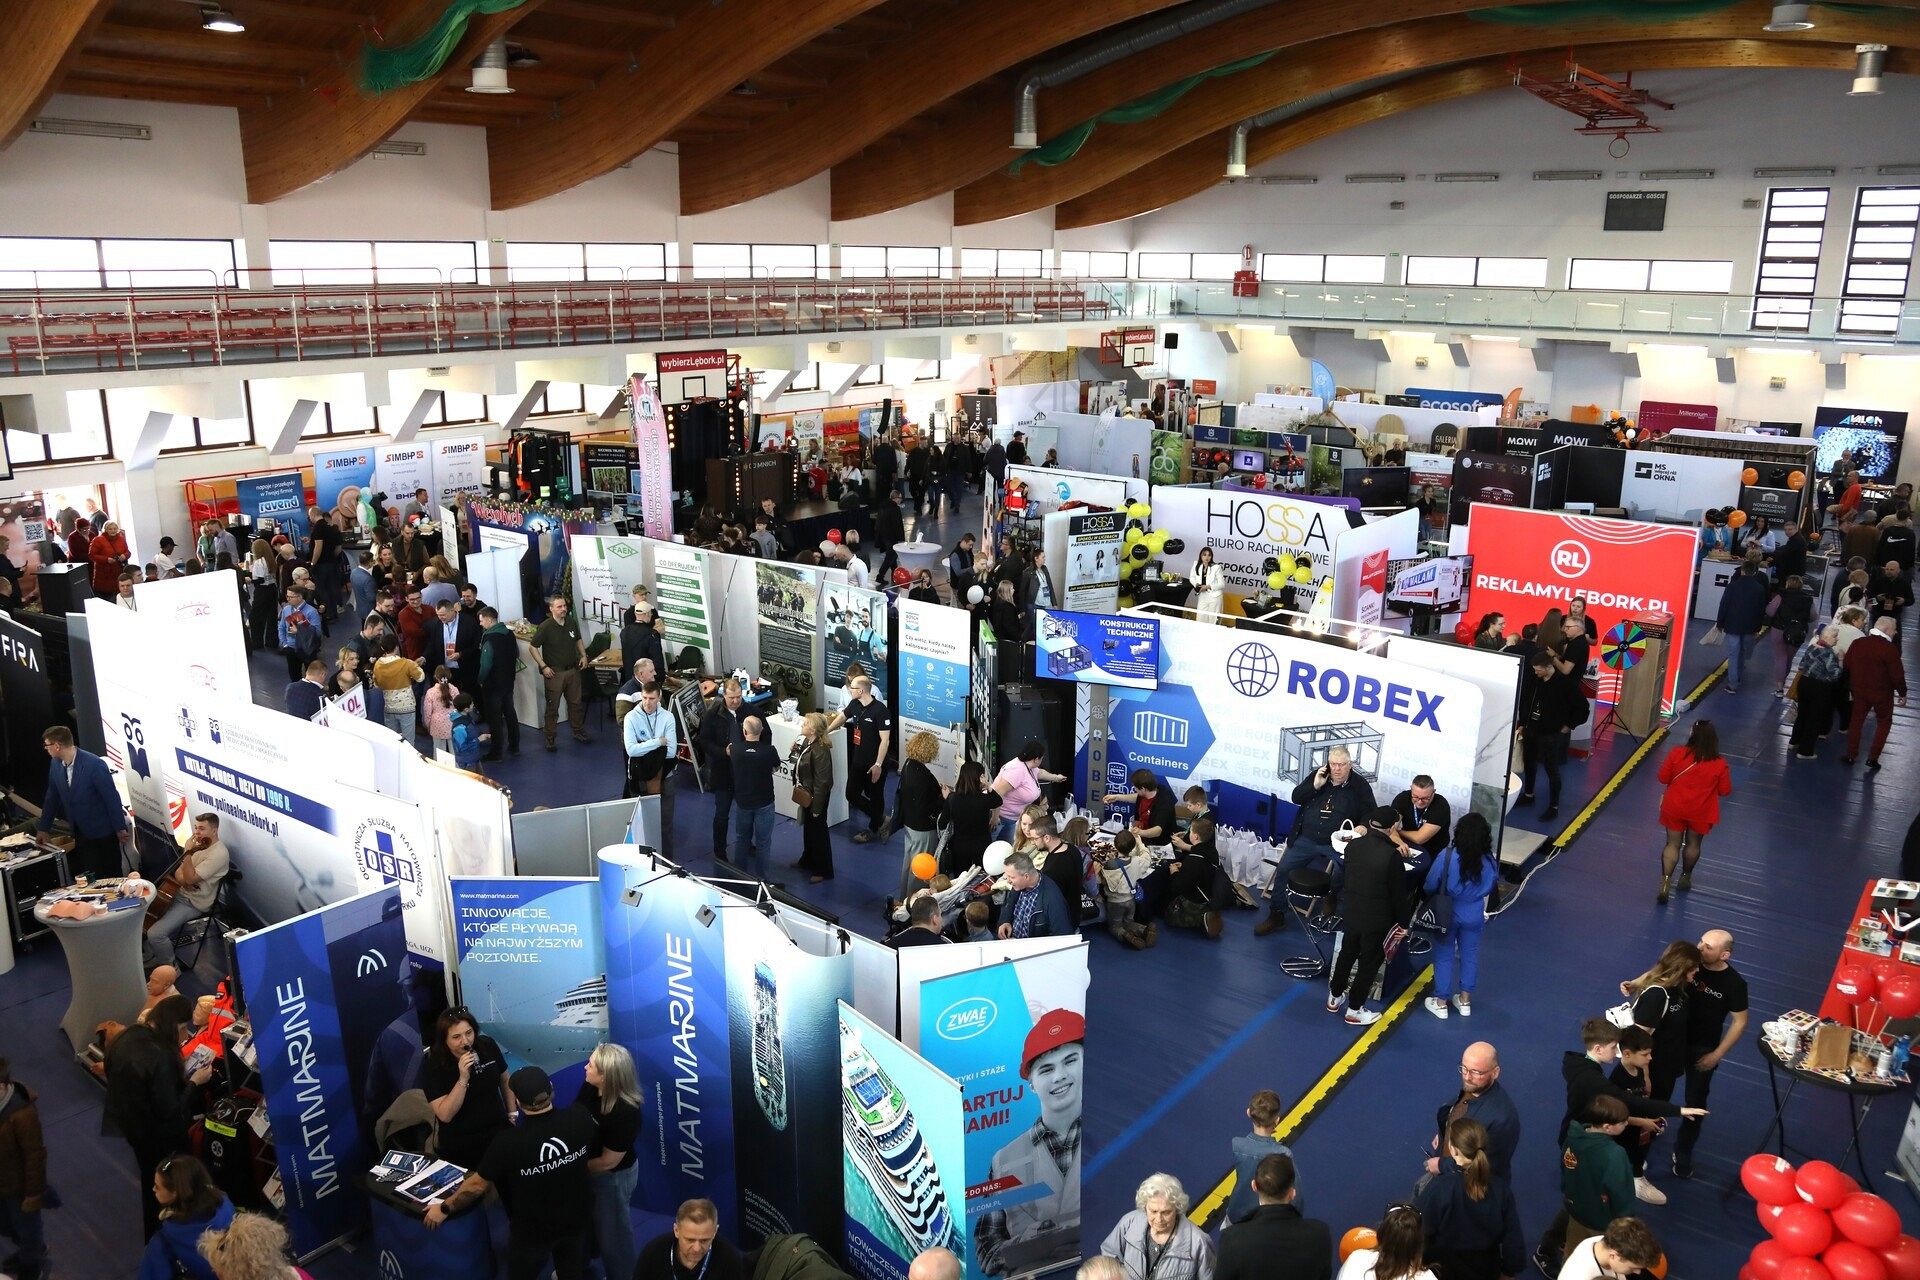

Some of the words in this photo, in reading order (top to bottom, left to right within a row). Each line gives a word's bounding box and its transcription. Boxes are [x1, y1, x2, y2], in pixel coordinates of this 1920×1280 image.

[662, 356, 724, 369] wybierzLębork.pl
[1678, 410, 1708, 418] Millennium
[1654, 474, 1676, 482] OKNA
[444, 485, 478, 494] CHEMIA
[258, 496, 300, 514] ravend
[1082, 516, 1114, 529] HOSSA
[1208, 498, 1330, 552] HOSSA
[1206, 537, 1244, 550] BIURO
[1248, 542, 1330, 566] RACHUNKOWE
[1556, 550, 1584, 568] RL
[1219, 562, 1258, 575] SPOKÓJ
[1476, 574, 1674, 614] REKLAMYLEBORK.PL
[1100, 619, 1154, 631] KONSTRUKCJE
[1106, 628, 1154, 639] TECHNICZNE
[1288, 660, 1445, 732] ROBEX
[1128, 751, 1189, 770] Containers
[1224, 742, 1270, 761] ROBEX
[1202, 758, 1228, 770] BEX
[266, 788, 284, 809] 1996
[1104, 804, 1130, 814] Steel
[367, 817, 396, 834] SŁUŻBA
[355, 822, 370, 881] OCHOTNICZA
[366, 850, 414, 882] OSR
[400, 834, 424, 898] RATOWNICZA
[462, 908, 551, 920] INNOWACJE,
[463, 921, 508, 933] KTÓRE
[512, 923, 578, 936] PŁYWAJĄ
[464, 938, 483, 948] NA
[486, 936, 583, 948] NAJWYŻSZYM
[466, 952, 542, 963] POZIOMIE.
[948, 1006, 988, 1030] ZWAE
[665, 932, 705, 1180] MATMARINE
[953, 1073, 974, 1084] TYKI
[980, 1065, 1007, 1078] STAŻE
[276, 976, 340, 1200] MATMARINE
[962, 1084, 1024, 1114] ARTUJ
[964, 1108, 1010, 1135] AMI!
[520, 1146, 586, 1176] MATMARINE
[970, 1187, 981, 1196] DO
[982, 1182, 1002, 1194] NAS:
[965, 1200, 1002, 1215] AE.COM.PL
